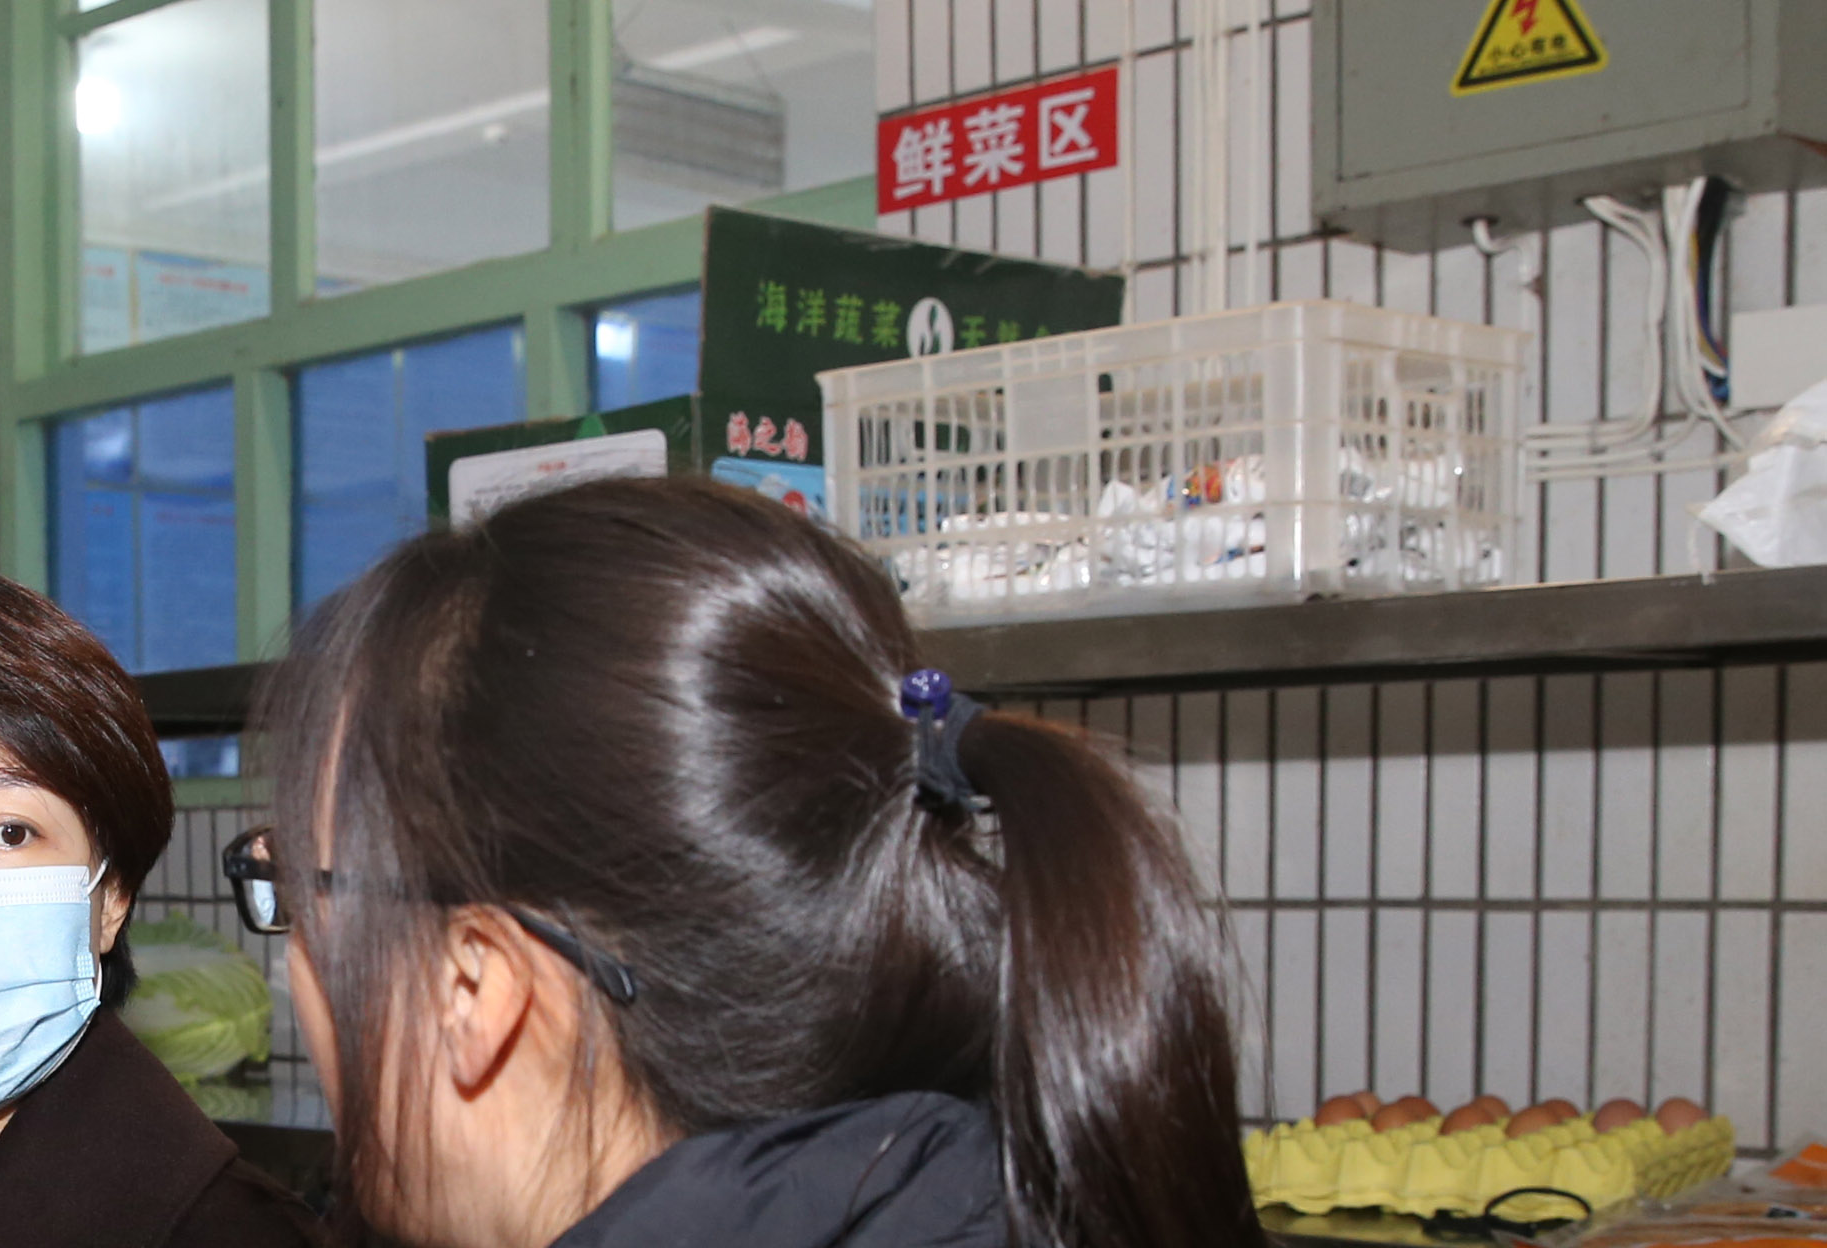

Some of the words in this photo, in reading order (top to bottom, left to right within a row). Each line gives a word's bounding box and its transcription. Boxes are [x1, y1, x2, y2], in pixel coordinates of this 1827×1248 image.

[891, 86, 1099, 200] 鲜菜区
[757, 280, 902, 349] 海洋蔬菜
